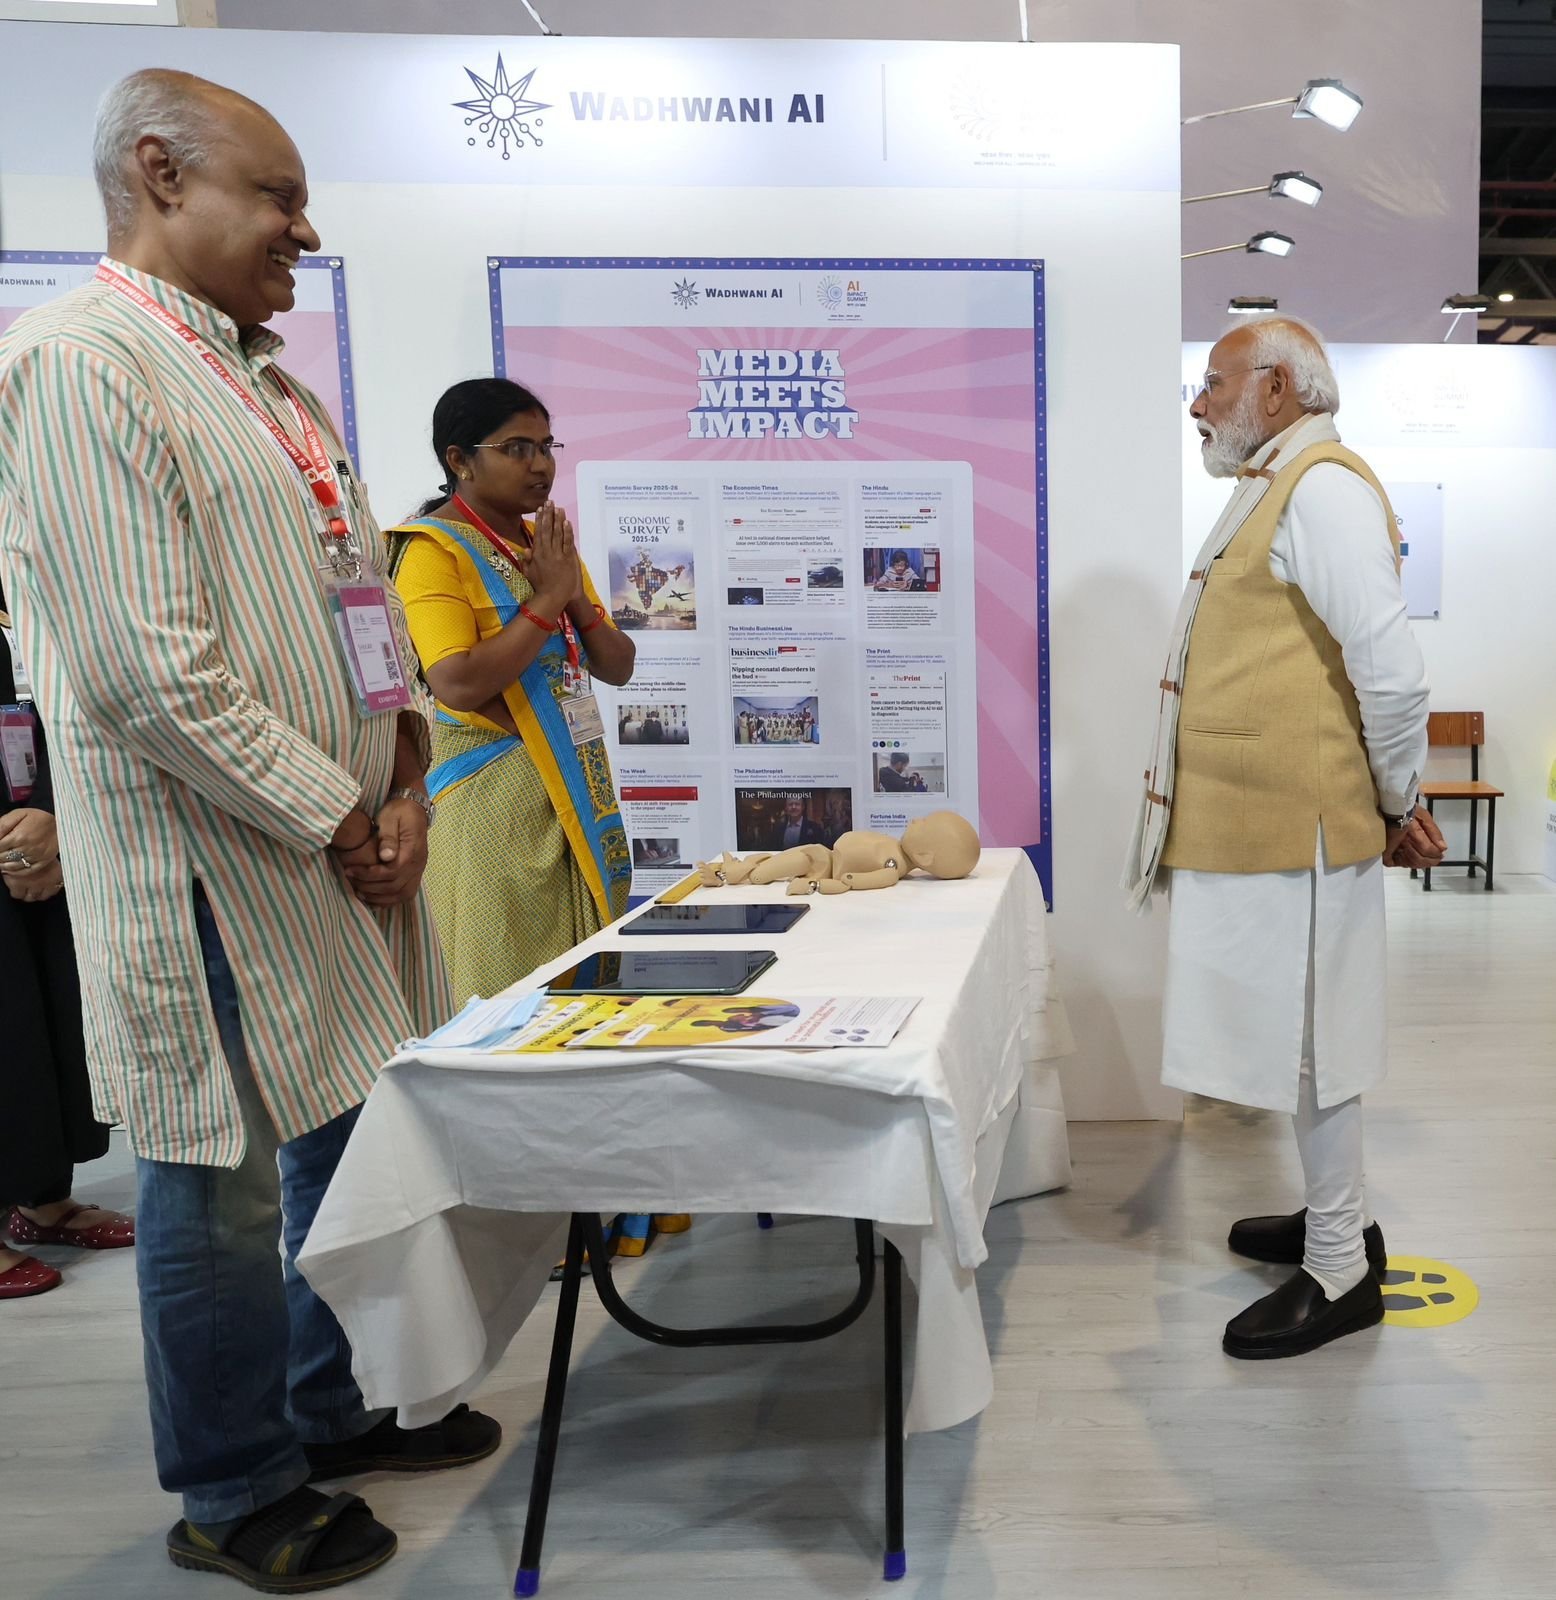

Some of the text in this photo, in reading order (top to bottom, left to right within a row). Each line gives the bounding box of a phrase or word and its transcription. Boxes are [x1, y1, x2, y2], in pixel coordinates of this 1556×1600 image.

[569, 91, 824, 123] WADHWANI AI
[111, 276, 147, 306] SUMMIT
[705, 288, 783, 298] WADHWANI AI
[847, 281, 860, 291] AI
[145, 301, 181, 332] IMPACT
[180, 329, 191, 340] AI
[696, 348, 846, 378] MEDIA
[225, 375, 244, 397] 2026
[697, 380, 847, 409] MEETS
[245, 395, 273, 429] SUMMIT
[686, 410, 859, 440] IMPACT
[273, 427, 300, 459] IMPACT
[308, 433, 322, 458] IMPACT
[298, 457, 308, 467] AI
[318, 459, 325, 467] AI
[618, 516, 671, 525] ECONOMIC
[619, 525, 670, 535] SURVEY
[631, 535, 659, 543] 2025-26
[740, 790, 813, 799] The Philanthropist
